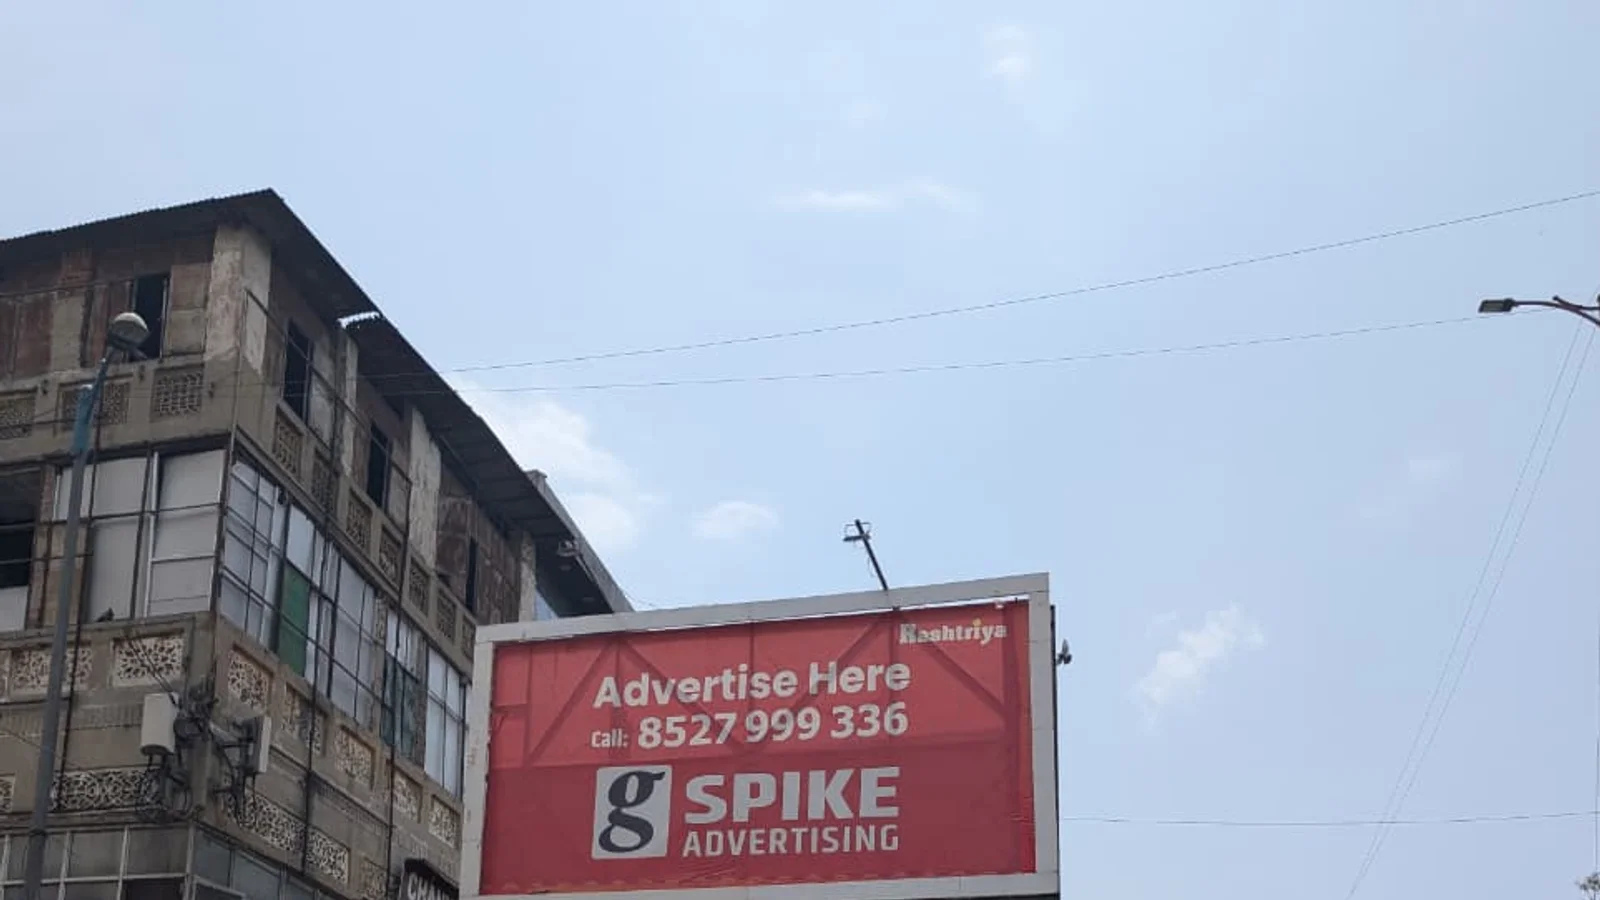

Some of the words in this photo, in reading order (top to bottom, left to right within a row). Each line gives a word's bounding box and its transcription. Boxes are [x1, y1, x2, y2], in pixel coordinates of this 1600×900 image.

[593, 664, 798, 708] Advertise
[808, 661, 911, 695] Here
[591, 730, 628, 748] Call:
[638, 713, 736, 749] 8527
[745, 708, 821, 743] 999
[831, 702, 908, 739] 336
[684, 766, 900, 825] SPIKE
[683, 824, 899, 857] ADVERTISING
